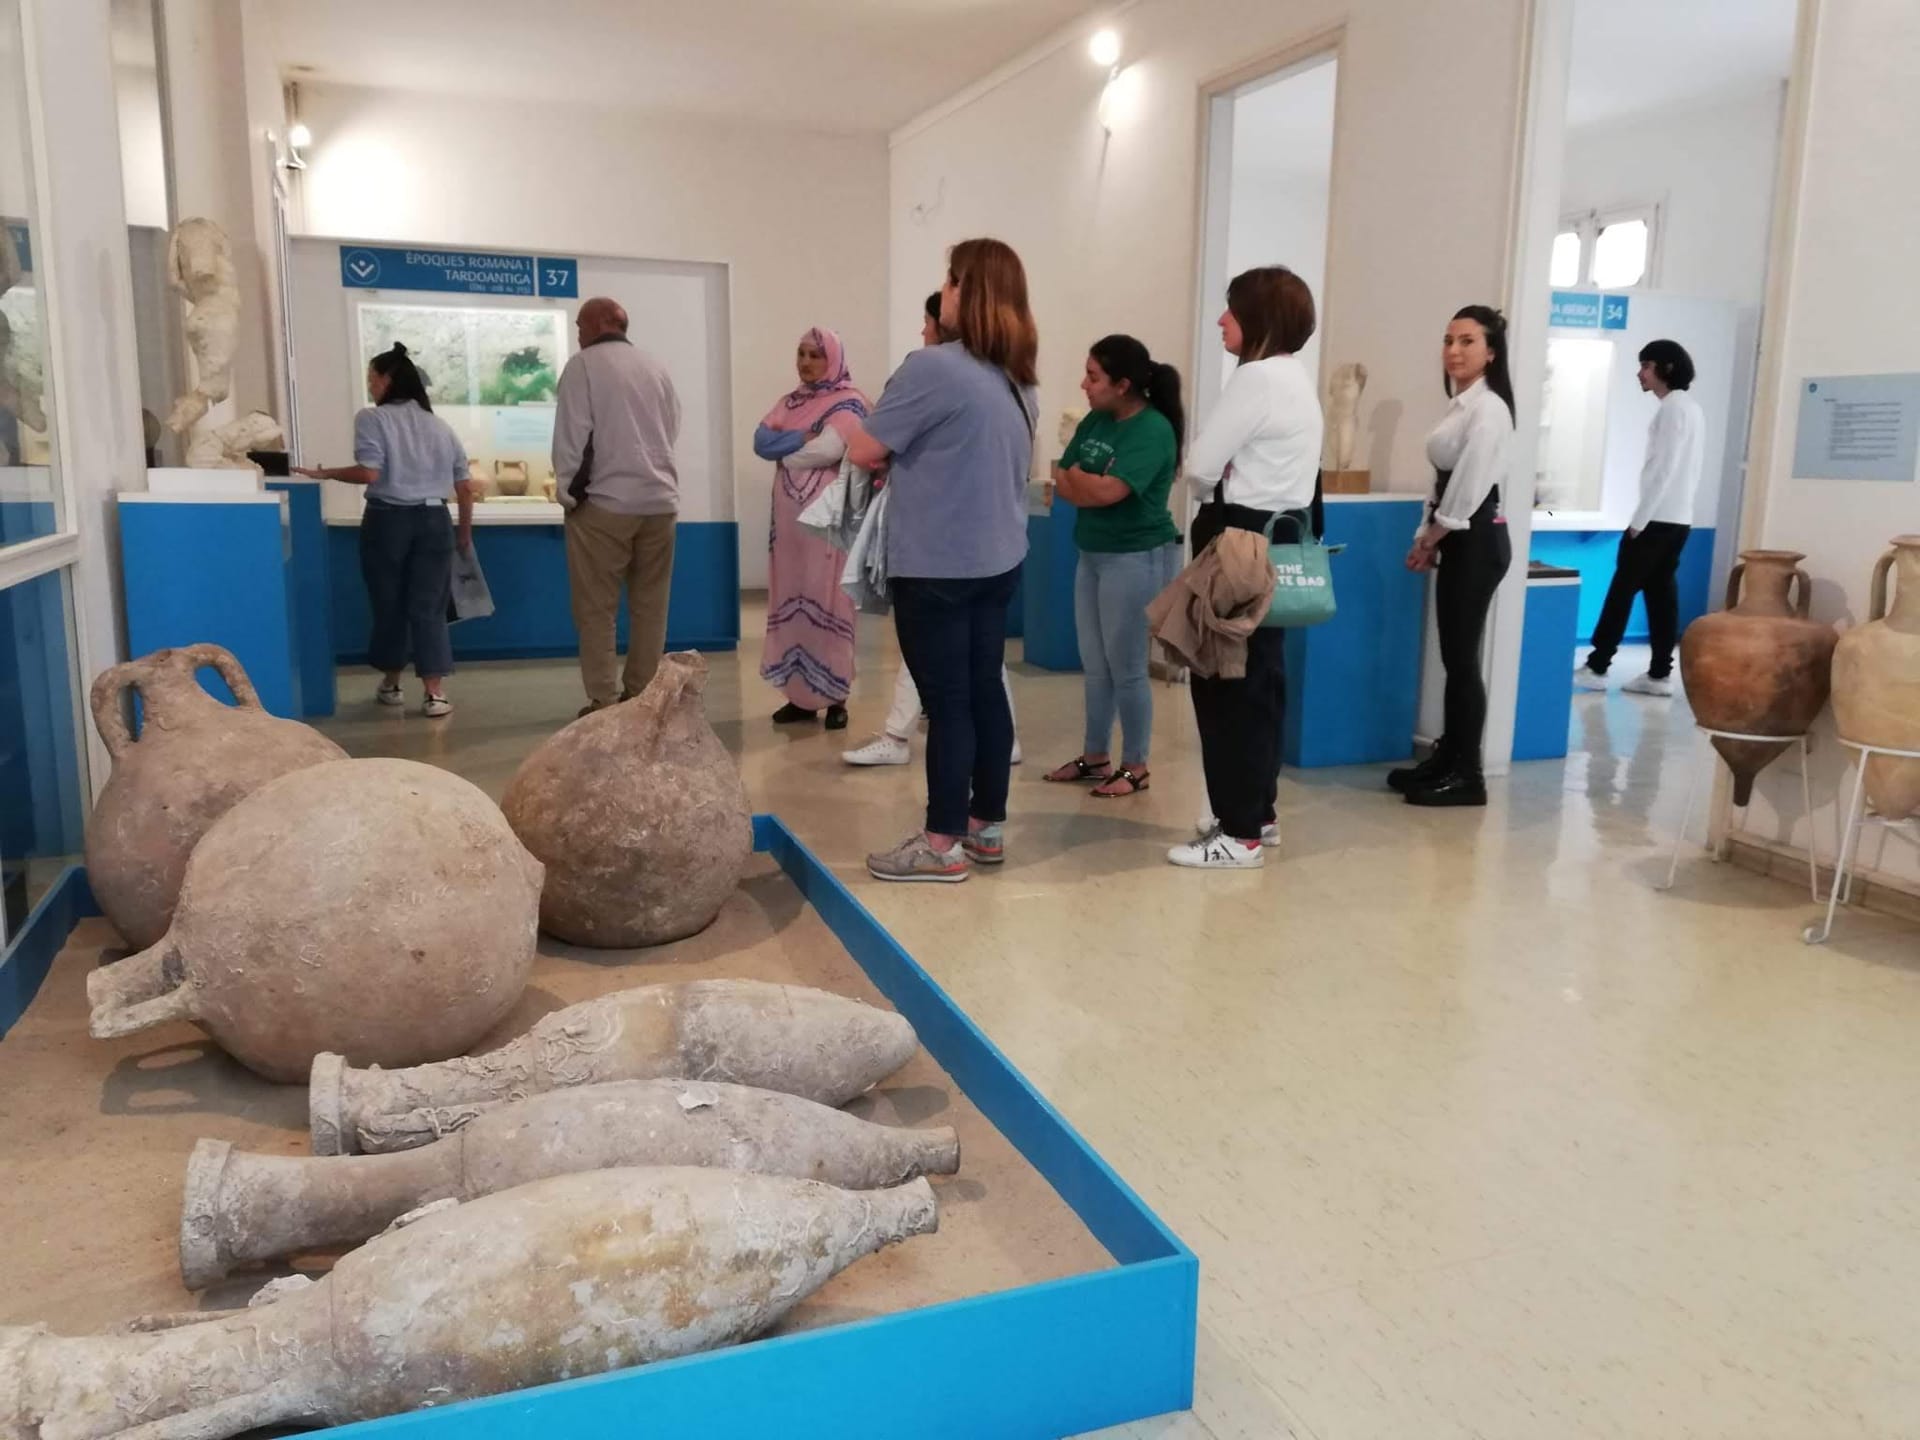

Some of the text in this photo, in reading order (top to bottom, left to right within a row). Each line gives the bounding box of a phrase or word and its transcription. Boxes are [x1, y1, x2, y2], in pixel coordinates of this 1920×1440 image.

[468, 256, 522, 270] ROMANA
[445, 269, 531, 284] TARDOANTIGA
[546, 269, 569, 286] 37
[1607, 304, 1623, 320] 34
[1276, 564, 1304, 575] THE
[1277, 575, 1325, 587] TE BAG
